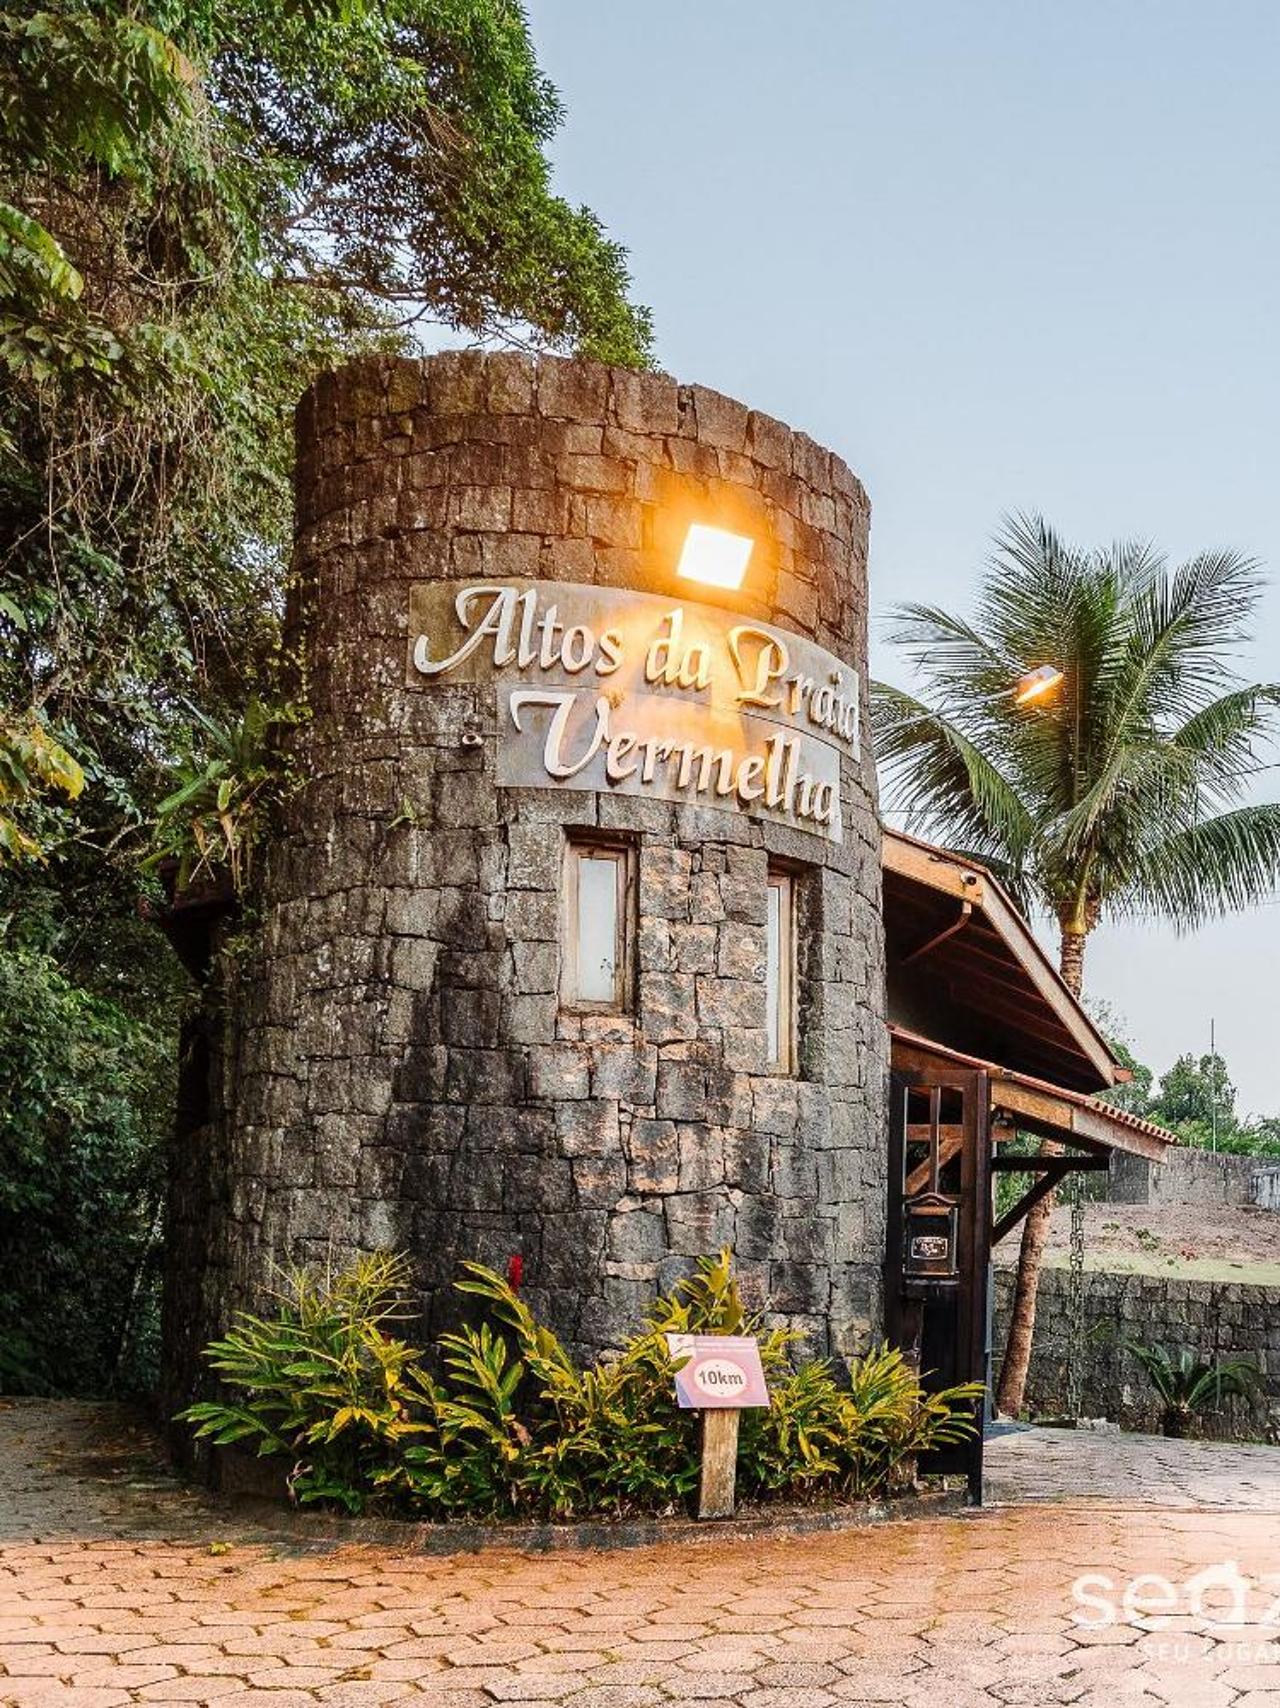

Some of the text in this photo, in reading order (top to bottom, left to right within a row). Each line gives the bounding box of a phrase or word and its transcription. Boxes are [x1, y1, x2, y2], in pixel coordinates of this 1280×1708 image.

[413, 585, 860, 744] Altos da Praia
[509, 689, 838, 826] Vermelha
[698, 1370, 744, 1386] 10km
